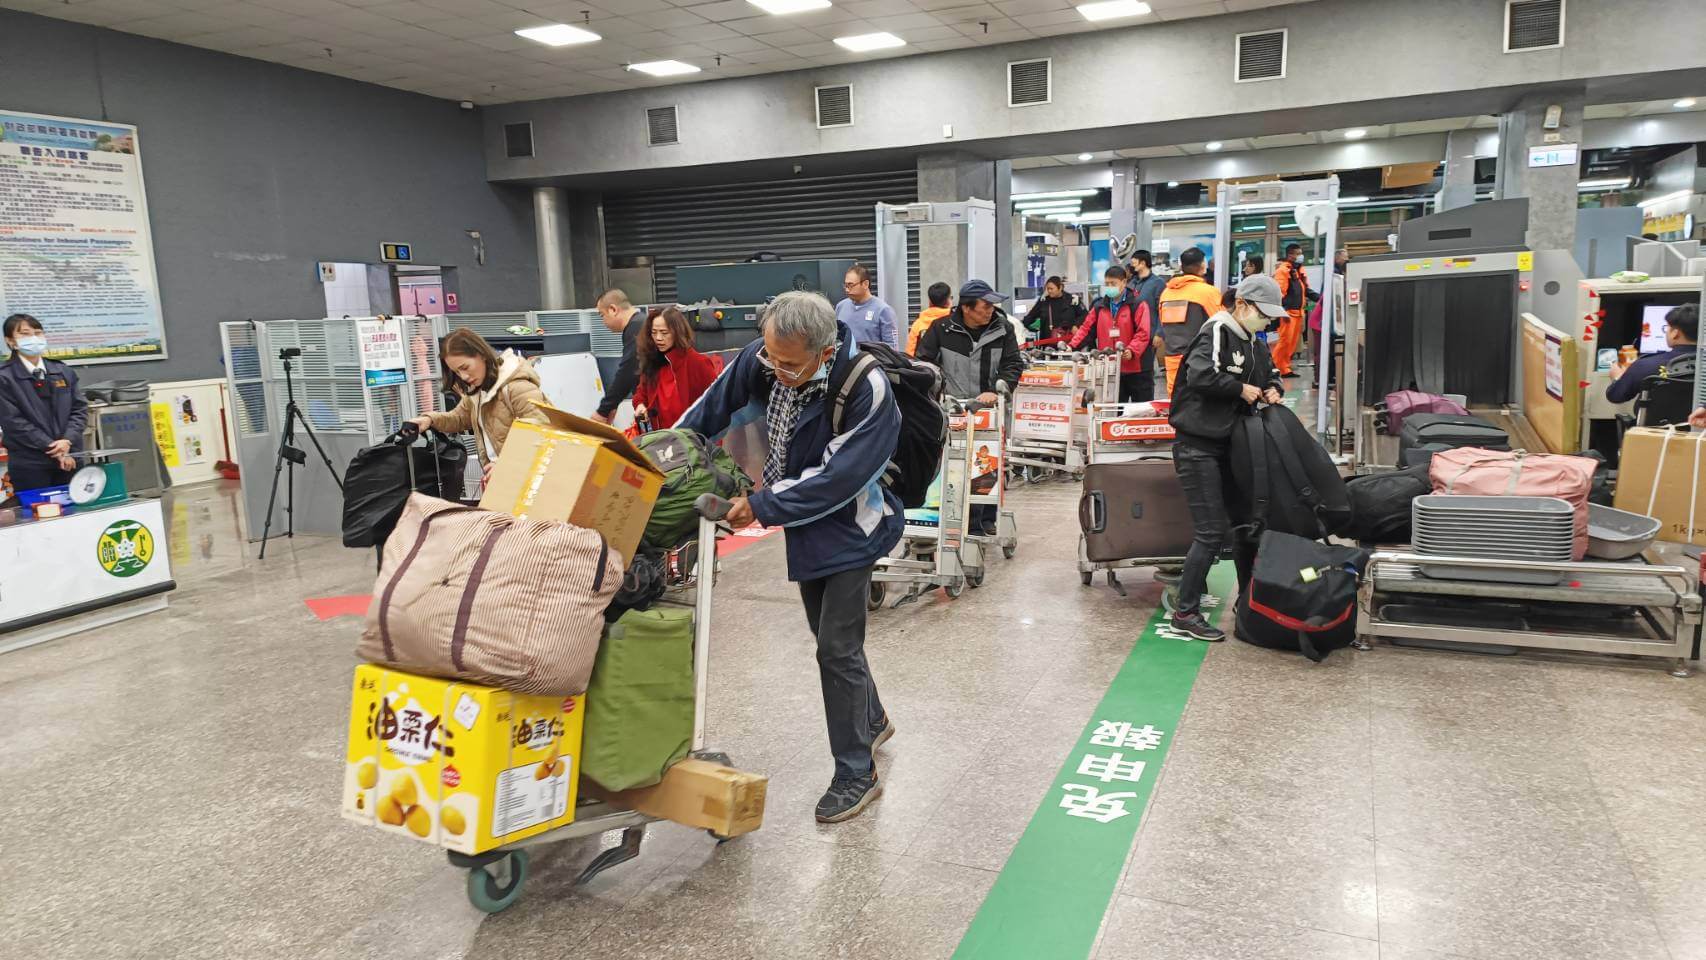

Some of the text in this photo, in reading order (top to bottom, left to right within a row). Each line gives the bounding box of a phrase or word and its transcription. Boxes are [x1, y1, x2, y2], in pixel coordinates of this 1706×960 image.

[367, 696, 454, 757] 油栗仁
[511, 716, 565, 749] 油栗仁
[1059, 719, 1165, 823] 免申報
